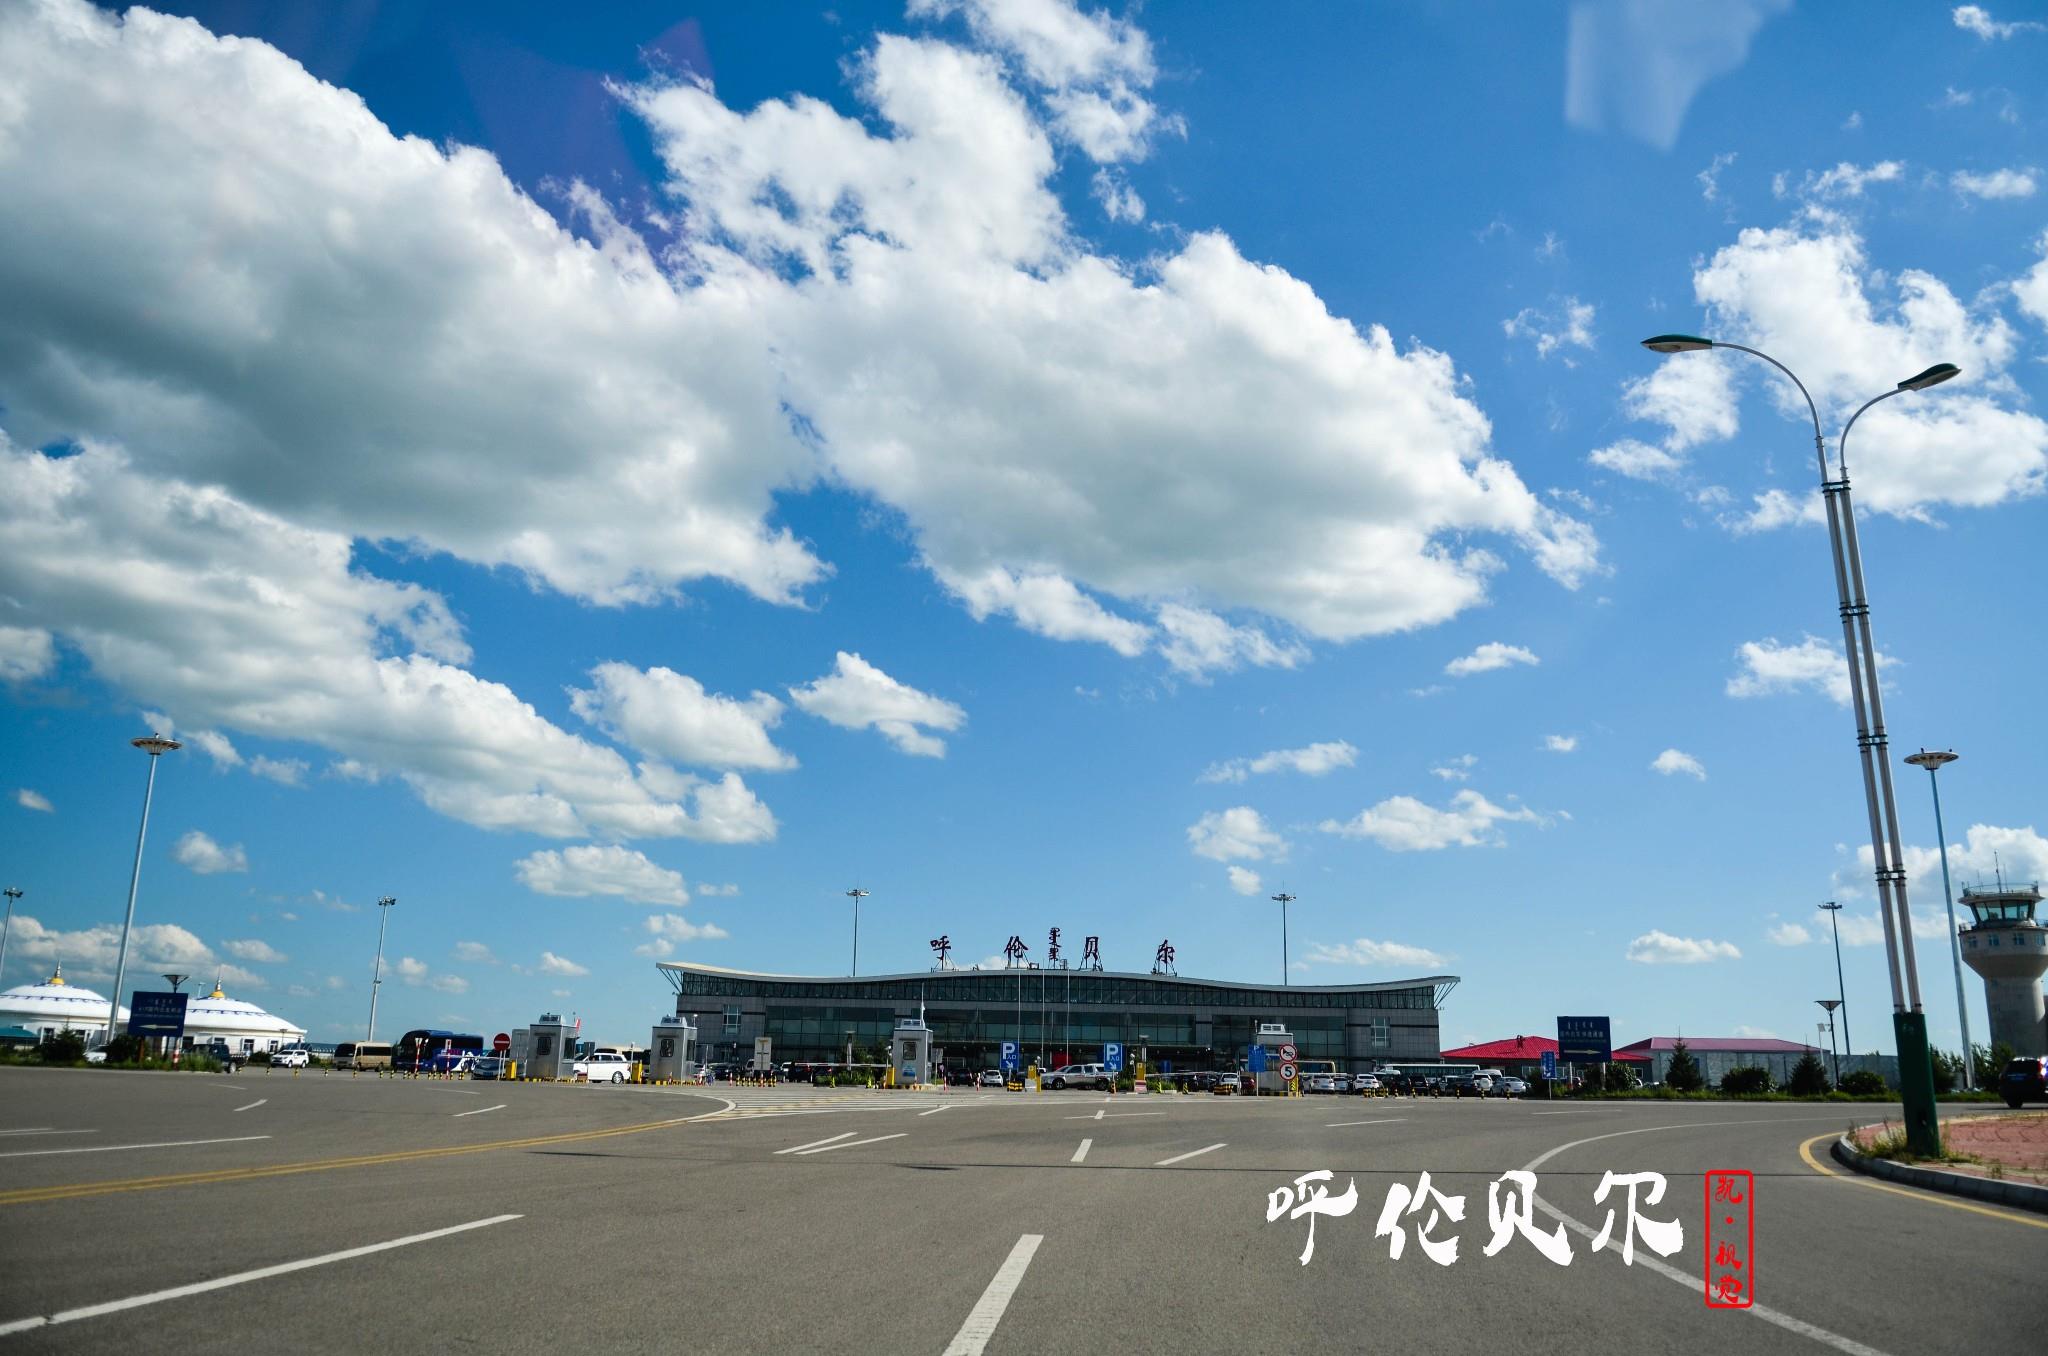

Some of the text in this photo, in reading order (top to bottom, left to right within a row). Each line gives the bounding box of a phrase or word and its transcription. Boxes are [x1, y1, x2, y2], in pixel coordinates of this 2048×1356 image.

[930, 935, 1175, 964] 呼伦贝尔
[1002, 1042, 1016, 1060] P
[1106, 1044, 1119, 1061] P
[1284, 1066, 1293, 1077] 5
